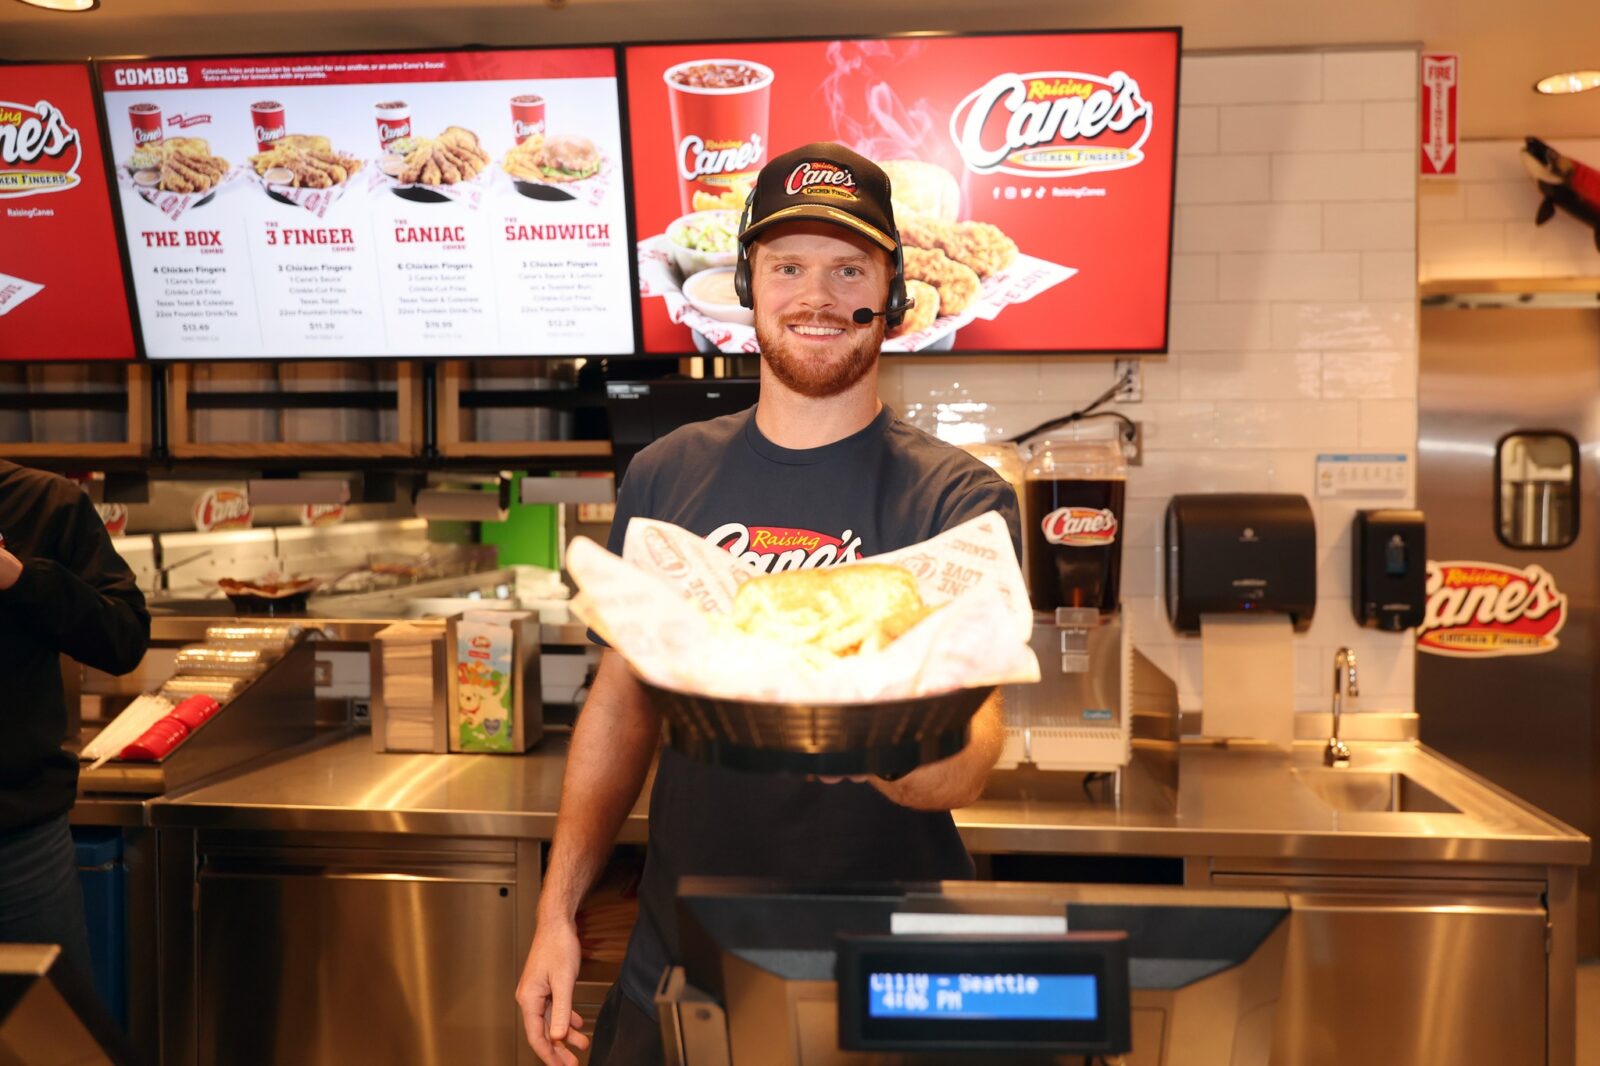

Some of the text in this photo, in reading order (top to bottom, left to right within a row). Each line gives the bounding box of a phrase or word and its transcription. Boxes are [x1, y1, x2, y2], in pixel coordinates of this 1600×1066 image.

[115, 67, 189, 86] COMBOS
[1428, 65, 1451, 80] FIRE
[1028, 79, 1093, 99] Raising
[962, 72, 1147, 167] Cane's
[679, 133, 764, 180] Cane's
[786, 163, 856, 195] Cane's
[7, 208, 54, 218] RaisingCanes
[142, 230, 222, 247] THE BOX
[266, 228, 354, 245] 3 FINGER
[395, 226, 465, 243] CANIAC
[505, 224, 610, 241] SANDWICH
[196, 266, 226, 274] Fingers
[285, 264, 319, 272] Chicken
[321, 264, 352, 273] Fingers
[441, 262, 473, 271] Fingers
[529, 260, 564, 268] Chicken
[566, 260, 598, 268] Fingers
[1047, 507, 1114, 541] Cane's
[752, 530, 820, 551] Raising
[958, 973, 1039, 995] Seattle
[936, 990, 963, 1010] PM
